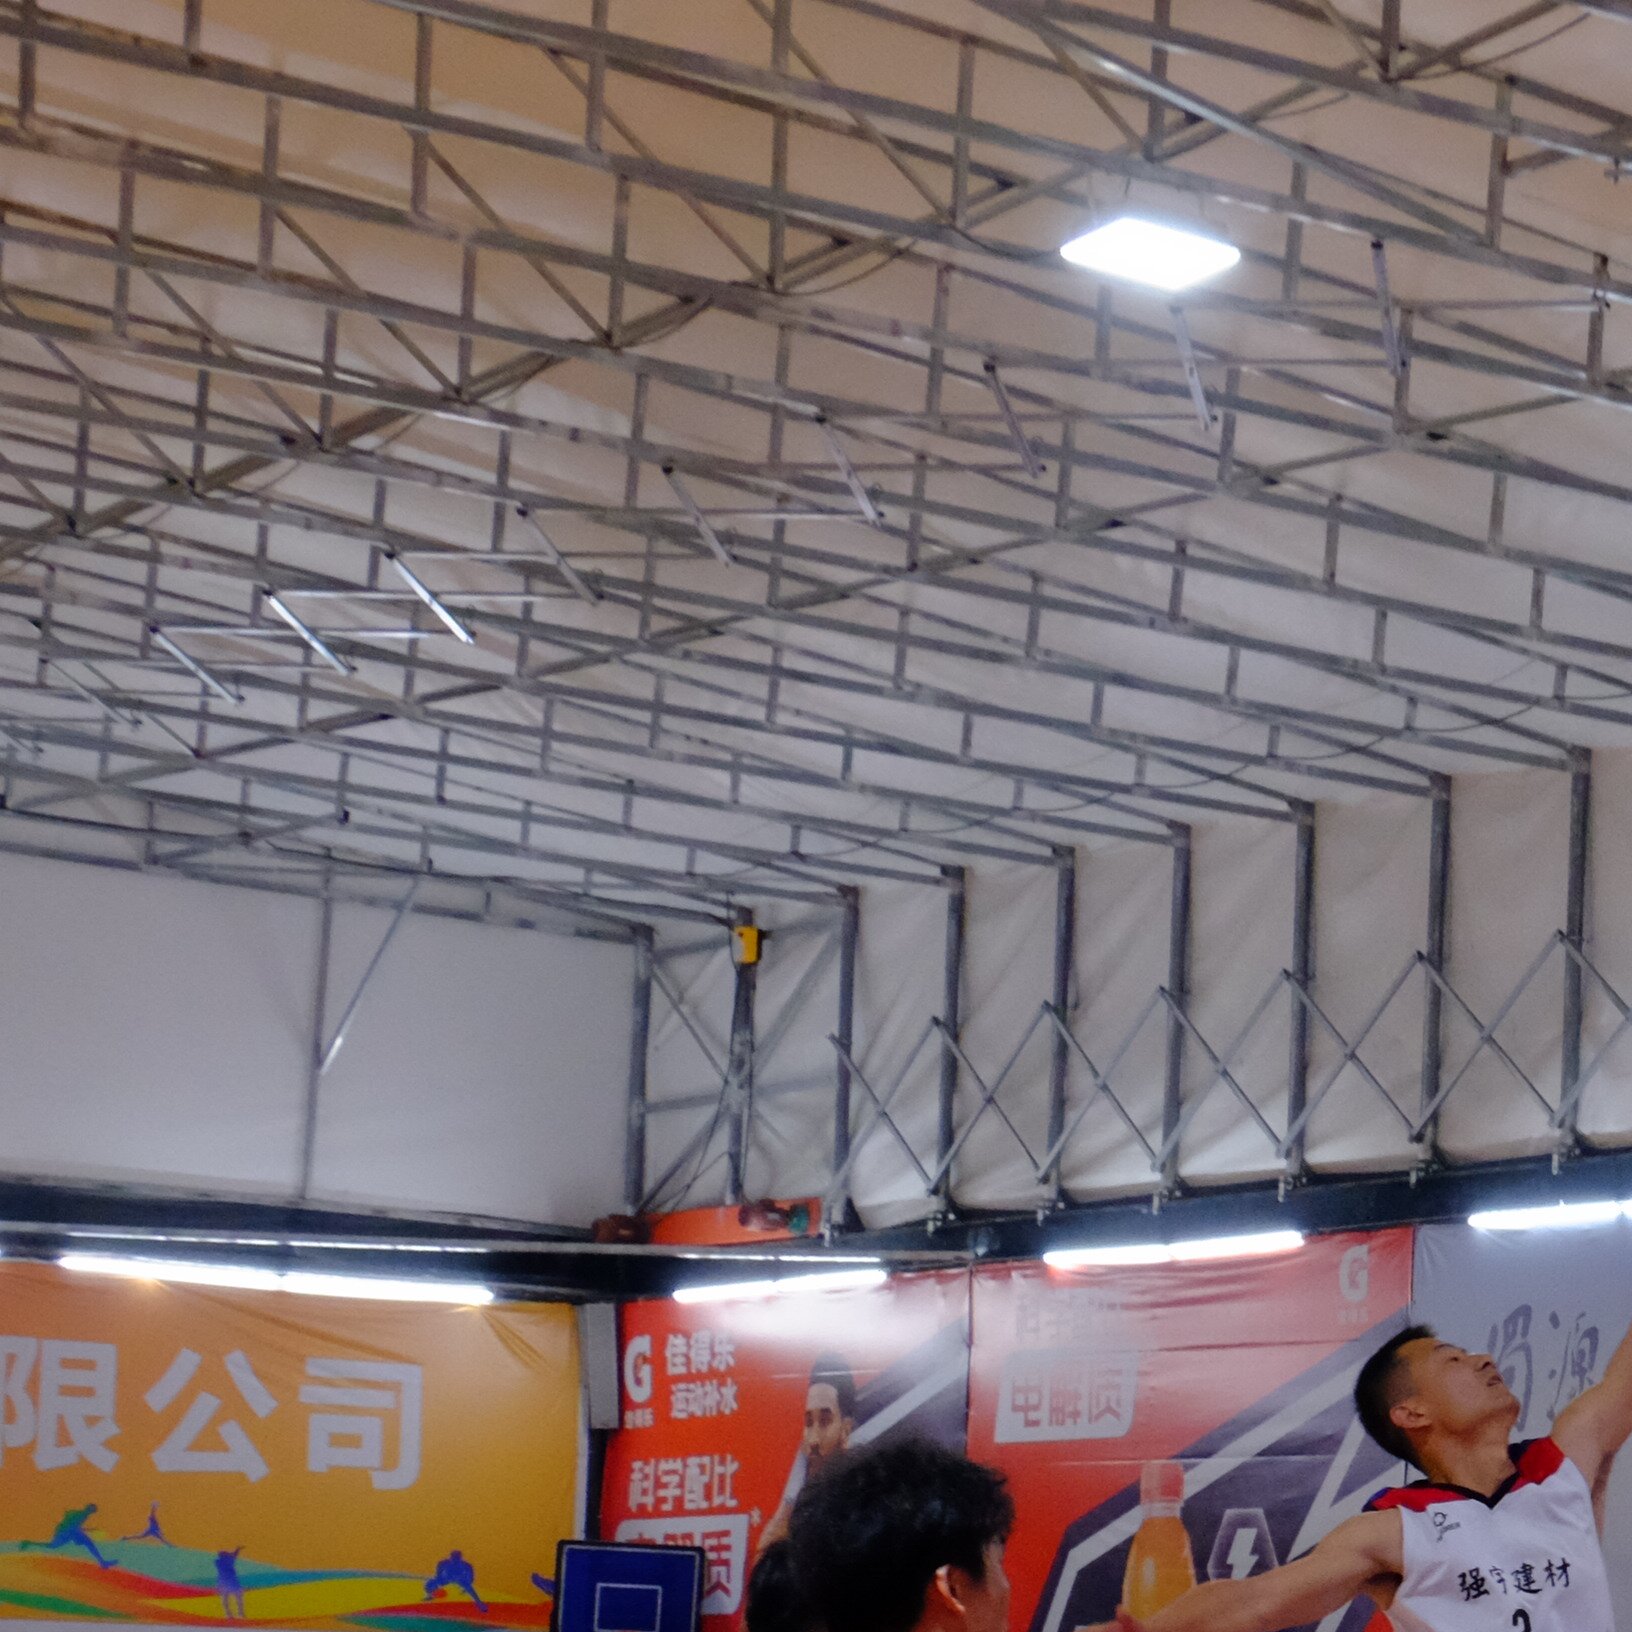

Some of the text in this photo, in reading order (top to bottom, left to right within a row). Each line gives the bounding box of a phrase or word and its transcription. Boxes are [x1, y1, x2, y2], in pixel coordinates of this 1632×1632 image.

[625, 1335, 652, 1402] G
[666, 1329, 735, 1376] 佳得乐
[671, 1378, 739, 1419] 运动补水
[628, 1455, 739, 1512] 科学配比
[1456, 1556, 1571, 1602] 强宇建材
